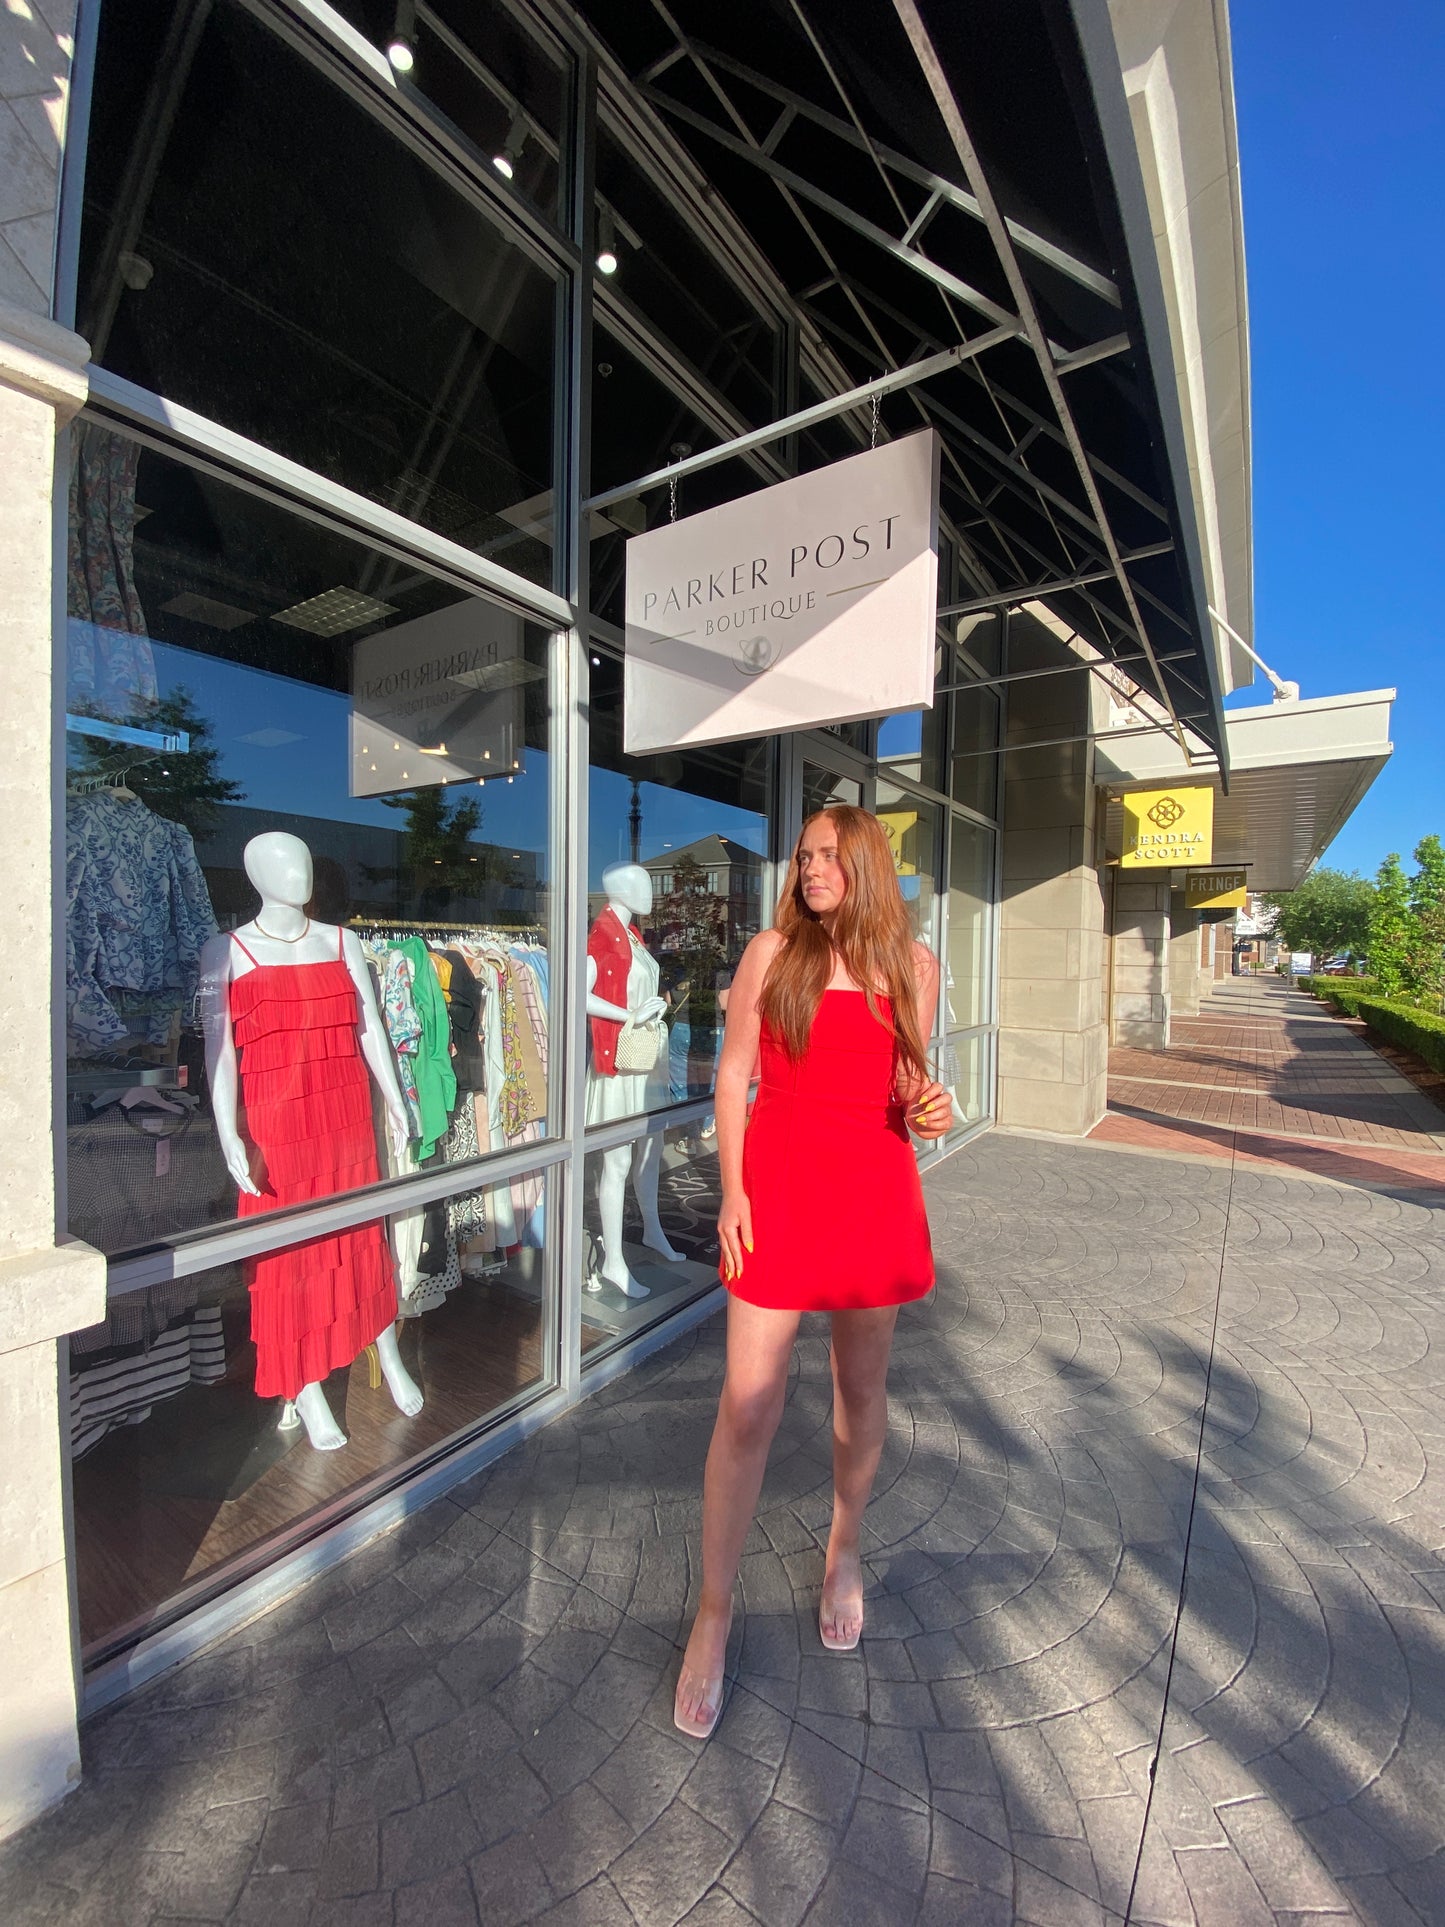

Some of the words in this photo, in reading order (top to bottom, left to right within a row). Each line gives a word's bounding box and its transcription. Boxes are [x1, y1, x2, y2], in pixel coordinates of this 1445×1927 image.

[643, 557, 769, 621] PARKER
[790, 515, 902, 578] POST
[705, 591, 817, 636] BOUTIQUE
[1130, 831, 1204, 846] KENDRA
[1134, 847, 1195, 860] SCOTT
[1190, 876, 1241, 892] FRINGE
